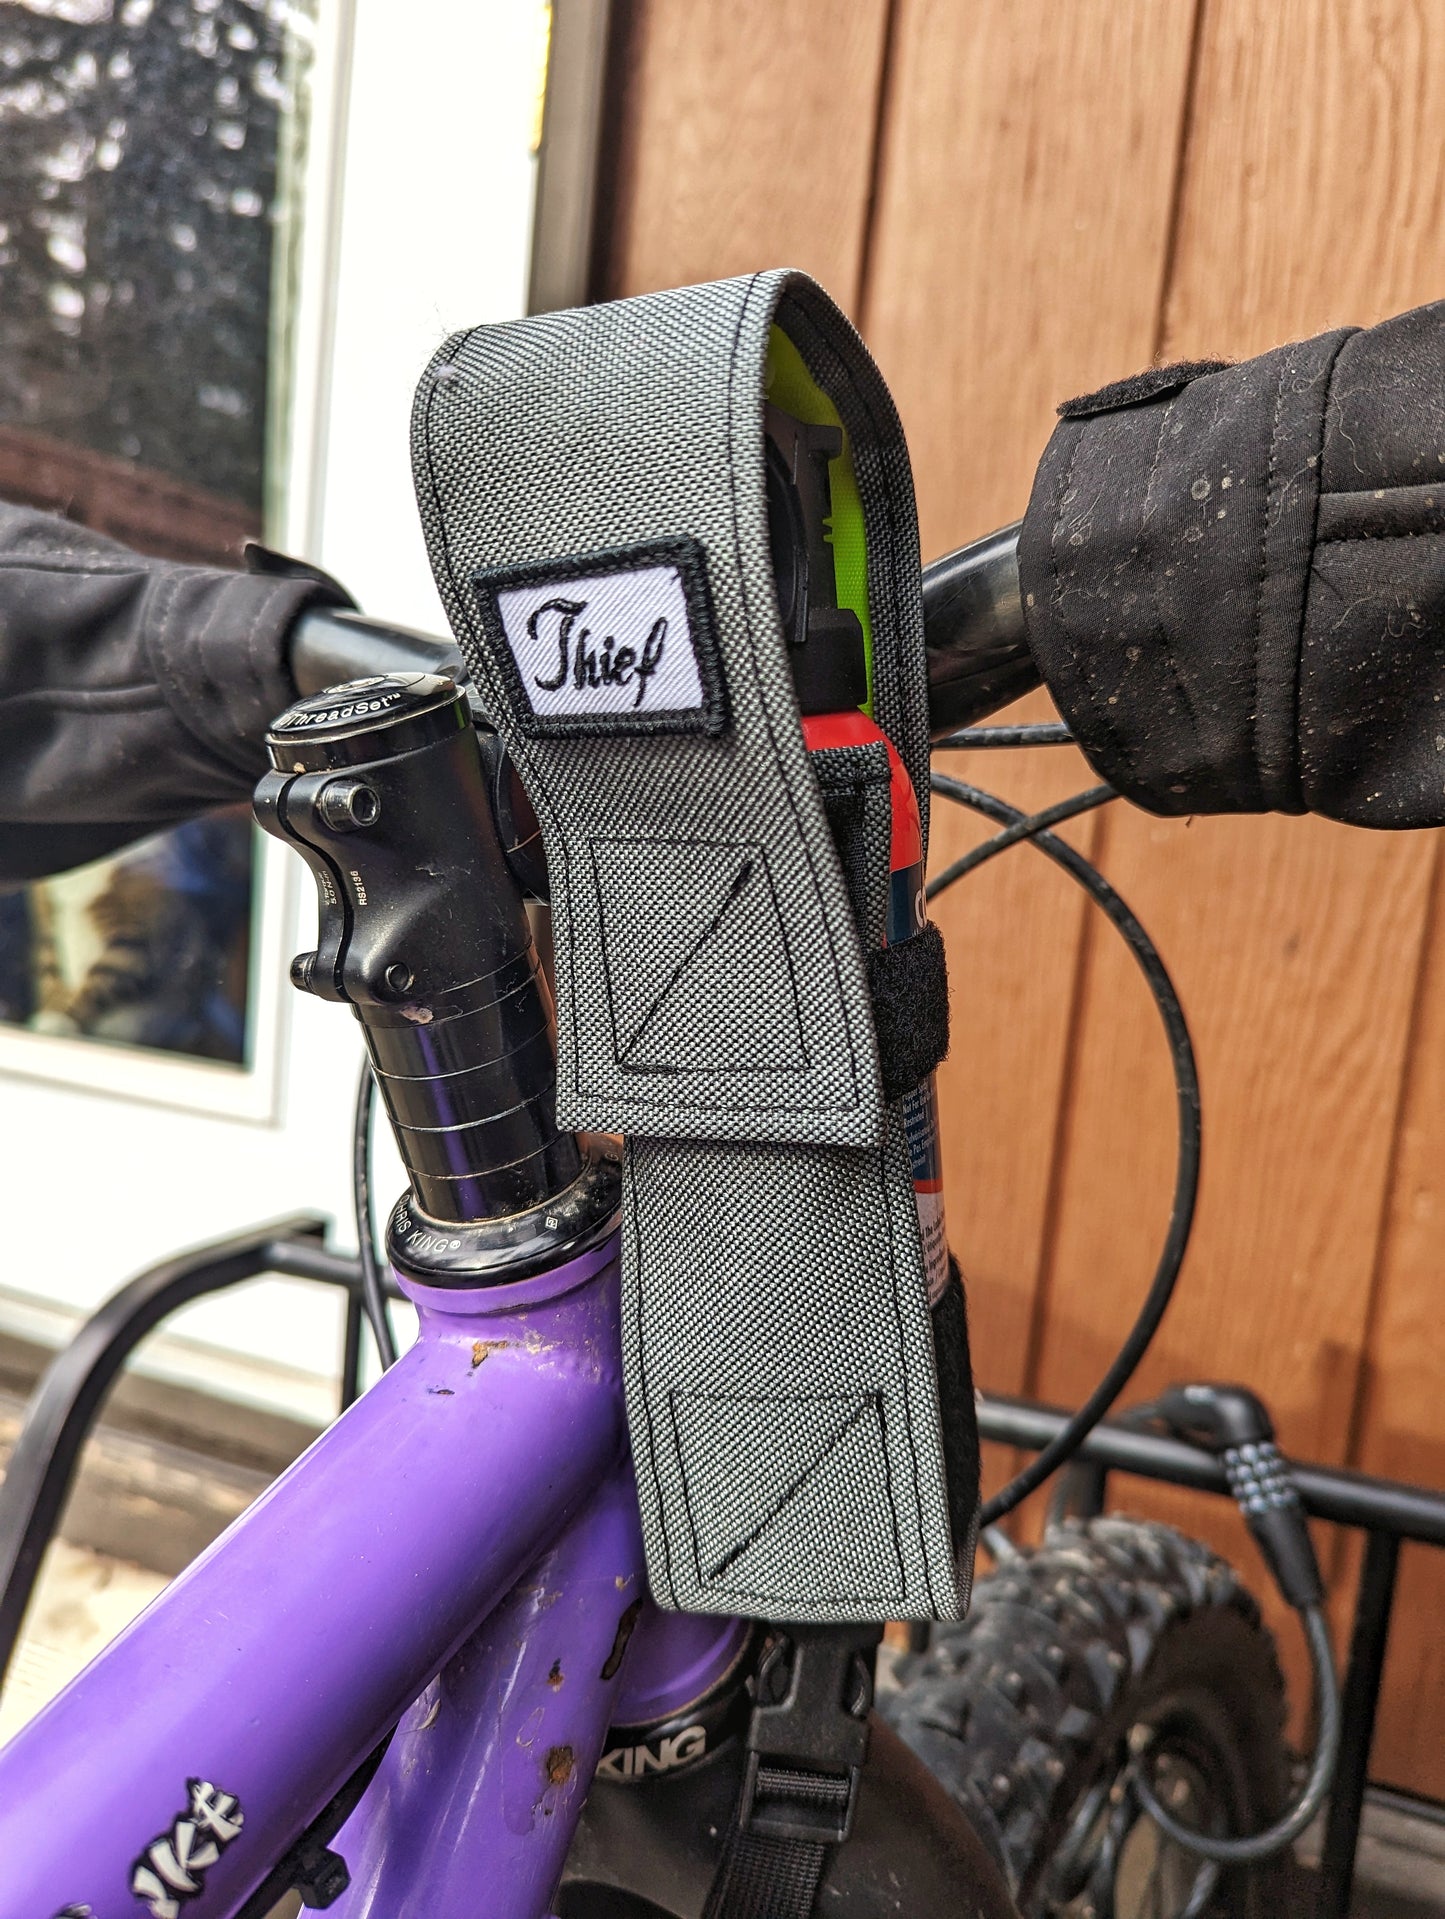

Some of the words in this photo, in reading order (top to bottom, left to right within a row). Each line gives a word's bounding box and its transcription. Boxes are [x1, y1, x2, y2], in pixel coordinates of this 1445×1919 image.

[527, 598, 667, 707] Thief
[395, 1194, 412, 1233] CHRIS
[595, 1725, 707, 1779] KING
